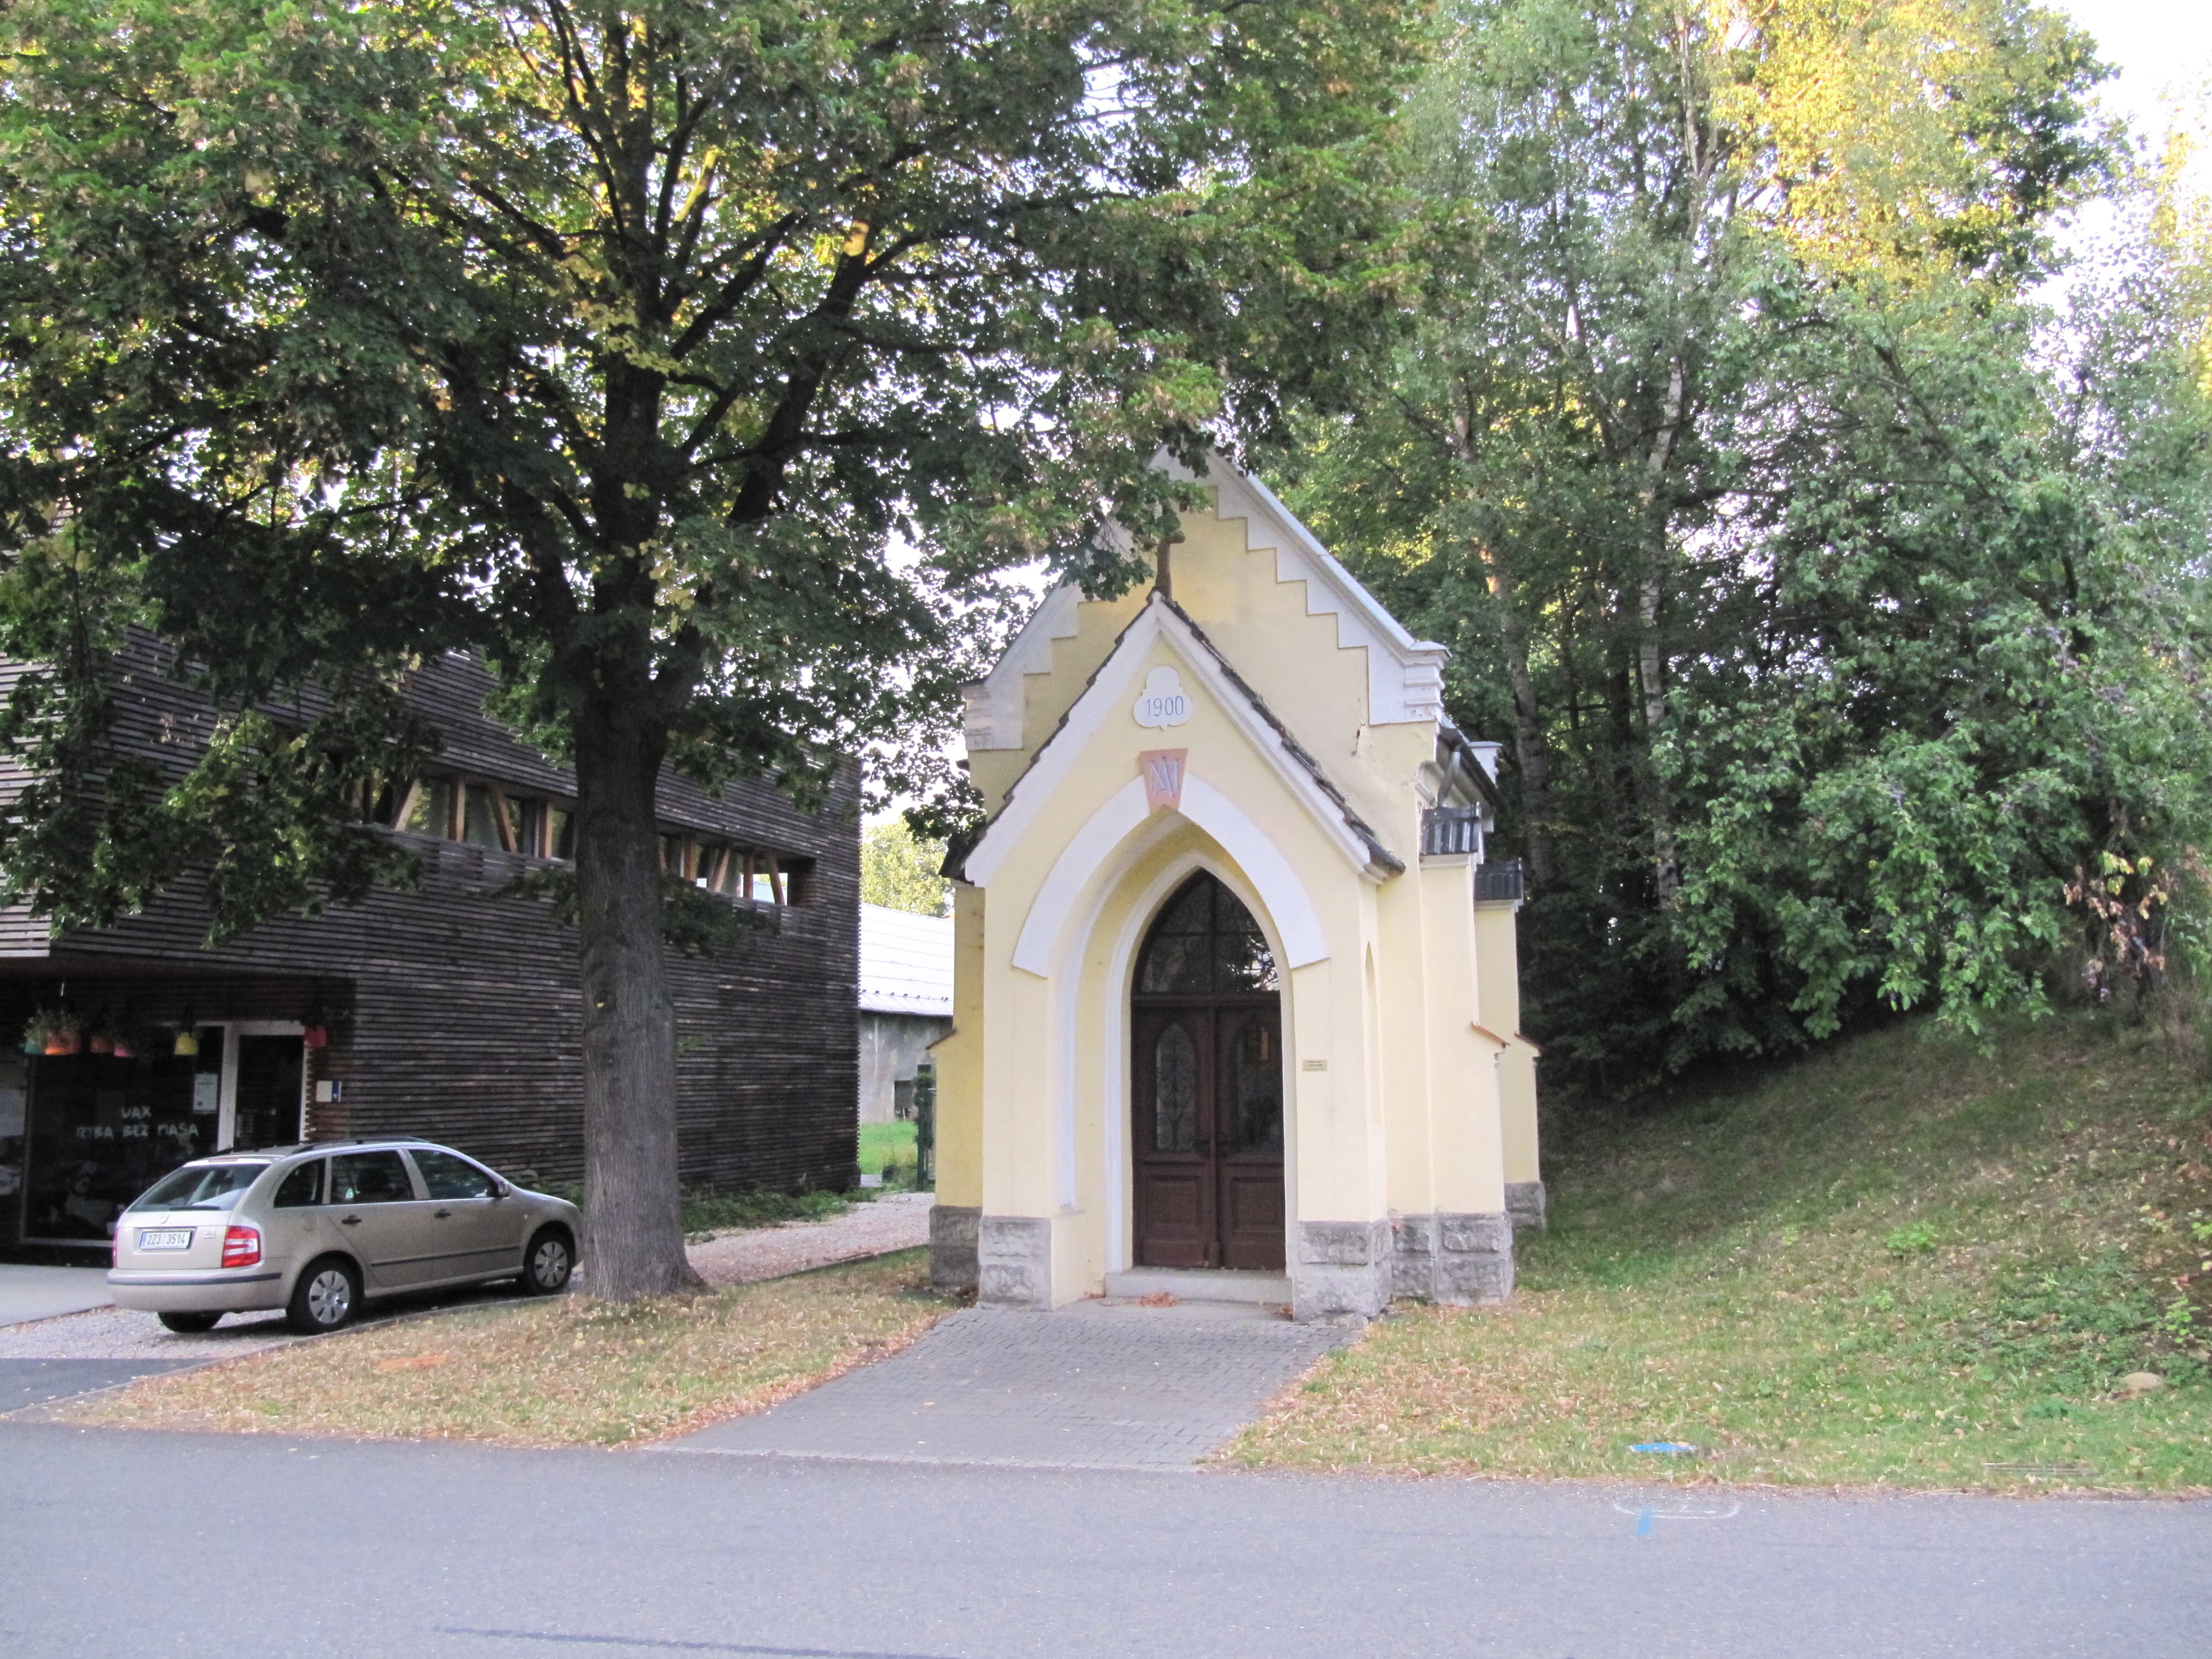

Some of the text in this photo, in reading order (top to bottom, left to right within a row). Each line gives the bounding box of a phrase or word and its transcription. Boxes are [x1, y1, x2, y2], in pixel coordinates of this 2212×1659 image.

[1145, 695, 1184, 717] 1900
[76, 1123, 199, 1139] RYBA BEZ MASA
[147, 1233, 185, 1245] 2Z3 3514
